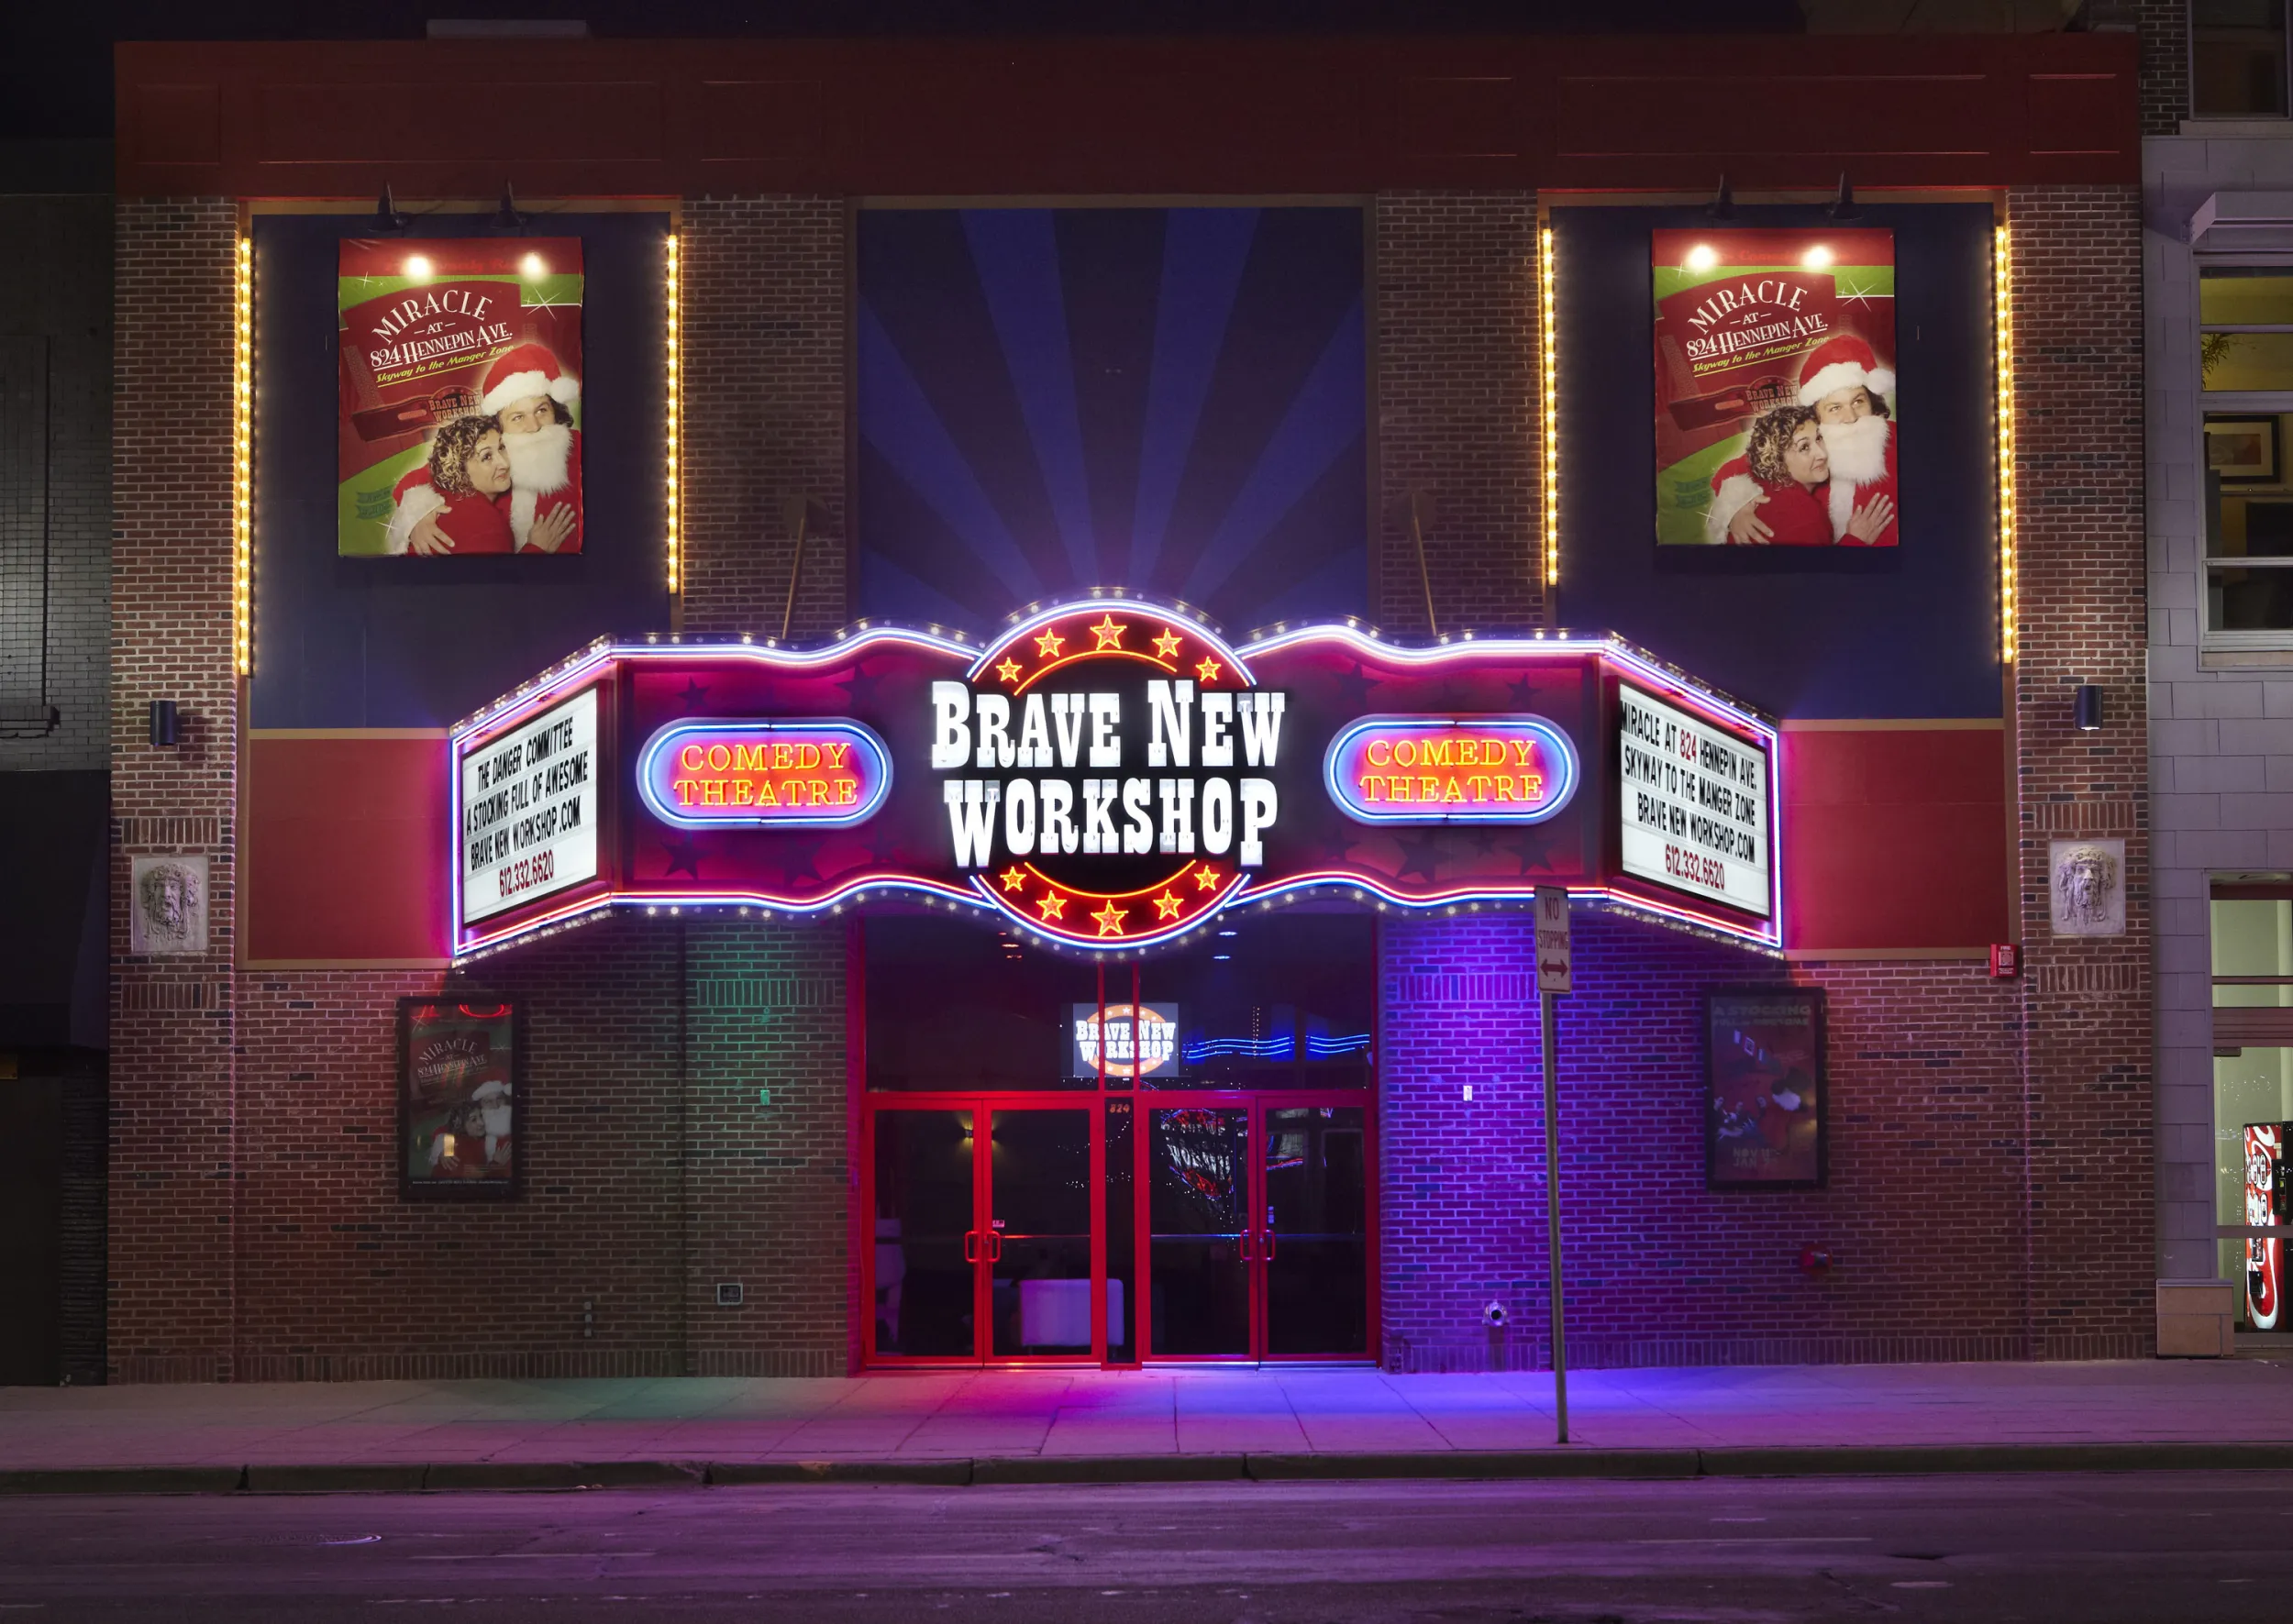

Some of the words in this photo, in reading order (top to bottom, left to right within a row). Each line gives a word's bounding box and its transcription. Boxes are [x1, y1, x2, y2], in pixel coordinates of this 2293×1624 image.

[371, 289, 493, 345] MIRACLE
[426, 322, 444, 335] AT
[1688, 280, 1808, 335] MIRACLE
[1742, 313, 1759, 325] AT
[370, 346, 401, 368] 824
[400, 330, 475, 364] HENNEPIN
[477, 322, 513, 348] AVE.
[1686, 335, 1718, 357] 824
[1717, 321, 1790, 354] HENNEPIN
[1792, 313, 1828, 338] AVE.
[1692, 356, 1730, 372] Skyway
[1732, 355, 1743, 364] to
[1745, 351, 1761, 360] the
[1763, 342, 1802, 357] Manger
[1804, 336, 1830, 347] Zone
[376, 366, 414, 383] Skyway
[415, 364, 426, 373] to
[428, 360, 445, 370] the
[447, 351, 486, 367] Manger
[489, 345, 514, 357] Zone
[429, 397, 457, 412] BRAVE
[460, 394, 481, 406] NEW
[931, 680, 1121, 768] BRAVE
[1147, 679, 1285, 767] NEW
[1621, 700, 1659, 746] MIRACLE
[1665, 723, 1677, 754] AT
[1680, 729, 1697, 764] 824
[1700, 737, 1737, 780] HENNEPIN
[1740, 757, 1757, 790] AVE.
[478, 761, 490, 792] THE
[493, 744, 523, 785] DANGER
[526, 716, 573, 768] COMMITTEE
[681, 743, 851, 771] COMEDY
[1367, 739, 1536, 768] COMEDY
[466, 808, 472, 836] A
[473, 790, 509, 832] STOCKING
[511, 779, 529, 814] FULL
[532, 773, 543, 802] OF
[545, 750, 588, 797] AWESOME
[673, 779, 858, 807] THEATRE
[1359, 775, 1544, 802] THEATRE
[1624, 745, 1663, 789] SKYWAY
[1665, 763, 1677, 794] TO
[1680, 769, 1696, 802] THE
[1699, 778, 1733, 822] MANGER
[1734, 792, 1756, 827] ZONE
[944, 777, 1279, 868] WORKSHOP
[1637, 791, 1667, 832] BRAVE
[1669, 805, 1688, 838] NEW
[471, 834, 493, 871] BRAVE
[494, 826, 510, 857] NEW
[1665, 844, 1724, 890] 612.332.6620
[499, 849, 554, 898] 612.332.6620
[1545, 897, 1559, 921] NO
[418, 1038, 477, 1066] MIRACLE
[1076, 1020, 1130, 1041] BRAVE
[1139, 1020, 1176, 1041] NEW
[1109, 1103, 1130, 1113] 824
